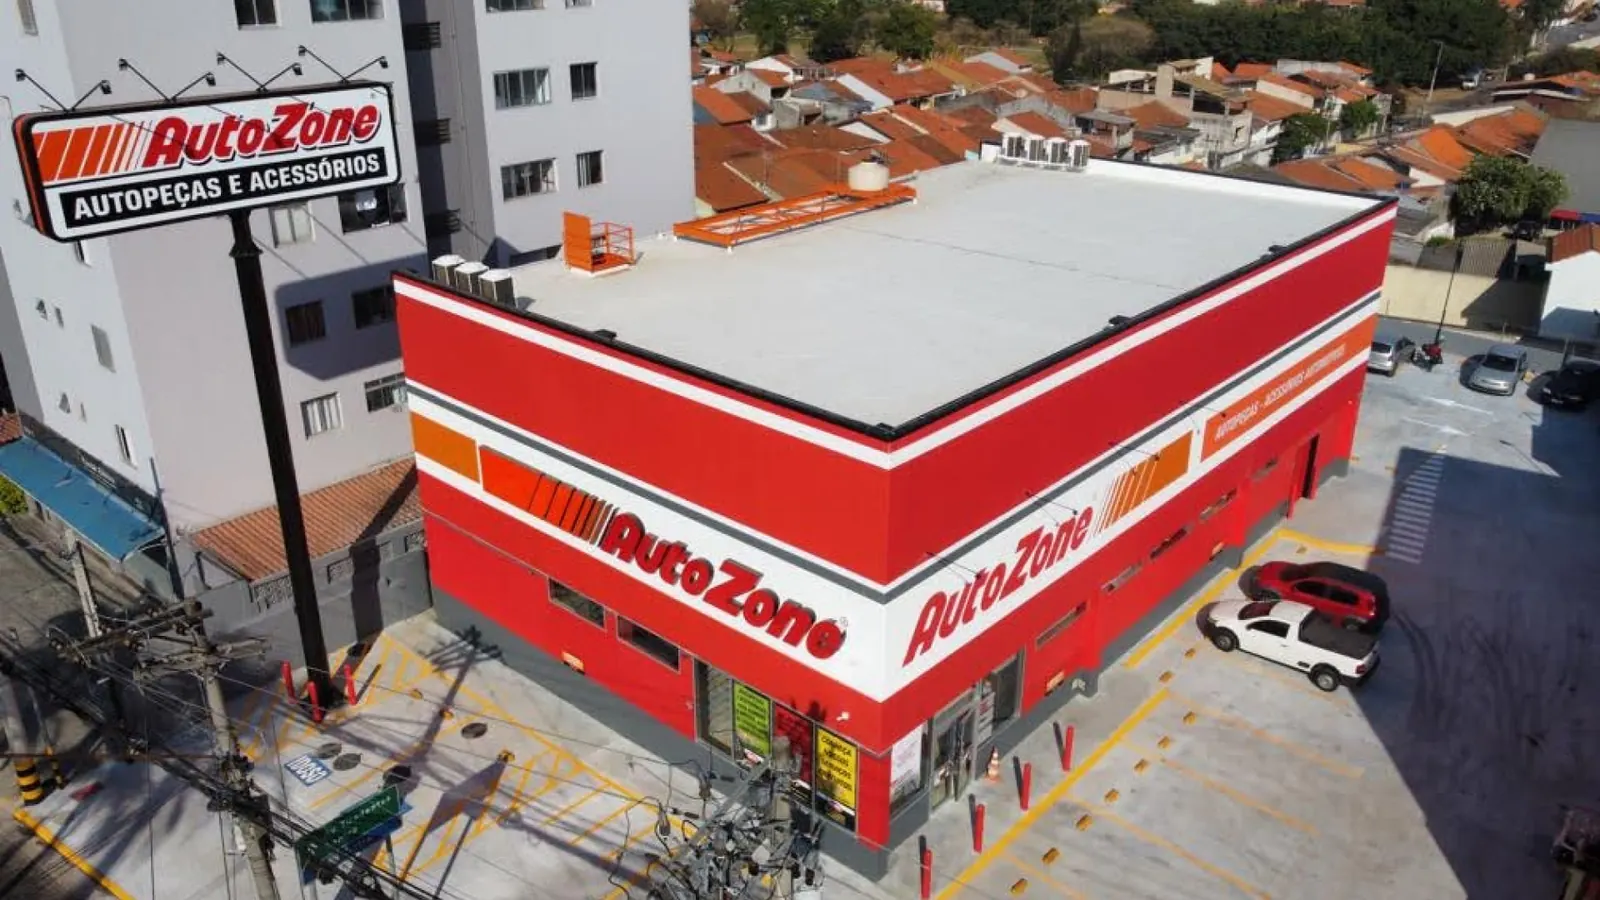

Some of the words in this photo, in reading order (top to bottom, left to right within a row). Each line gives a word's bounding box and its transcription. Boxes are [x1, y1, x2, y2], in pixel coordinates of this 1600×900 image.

[74, 177, 222, 221] AUTOPEÇAS
[229, 175, 243, 195] E
[250, 153, 381, 190] ACESSÓRIOS
[142, 102, 381, 168] AutoZone
[600, 513, 847, 660] AutoZone
[902, 506, 1093, 668] AutoZone
